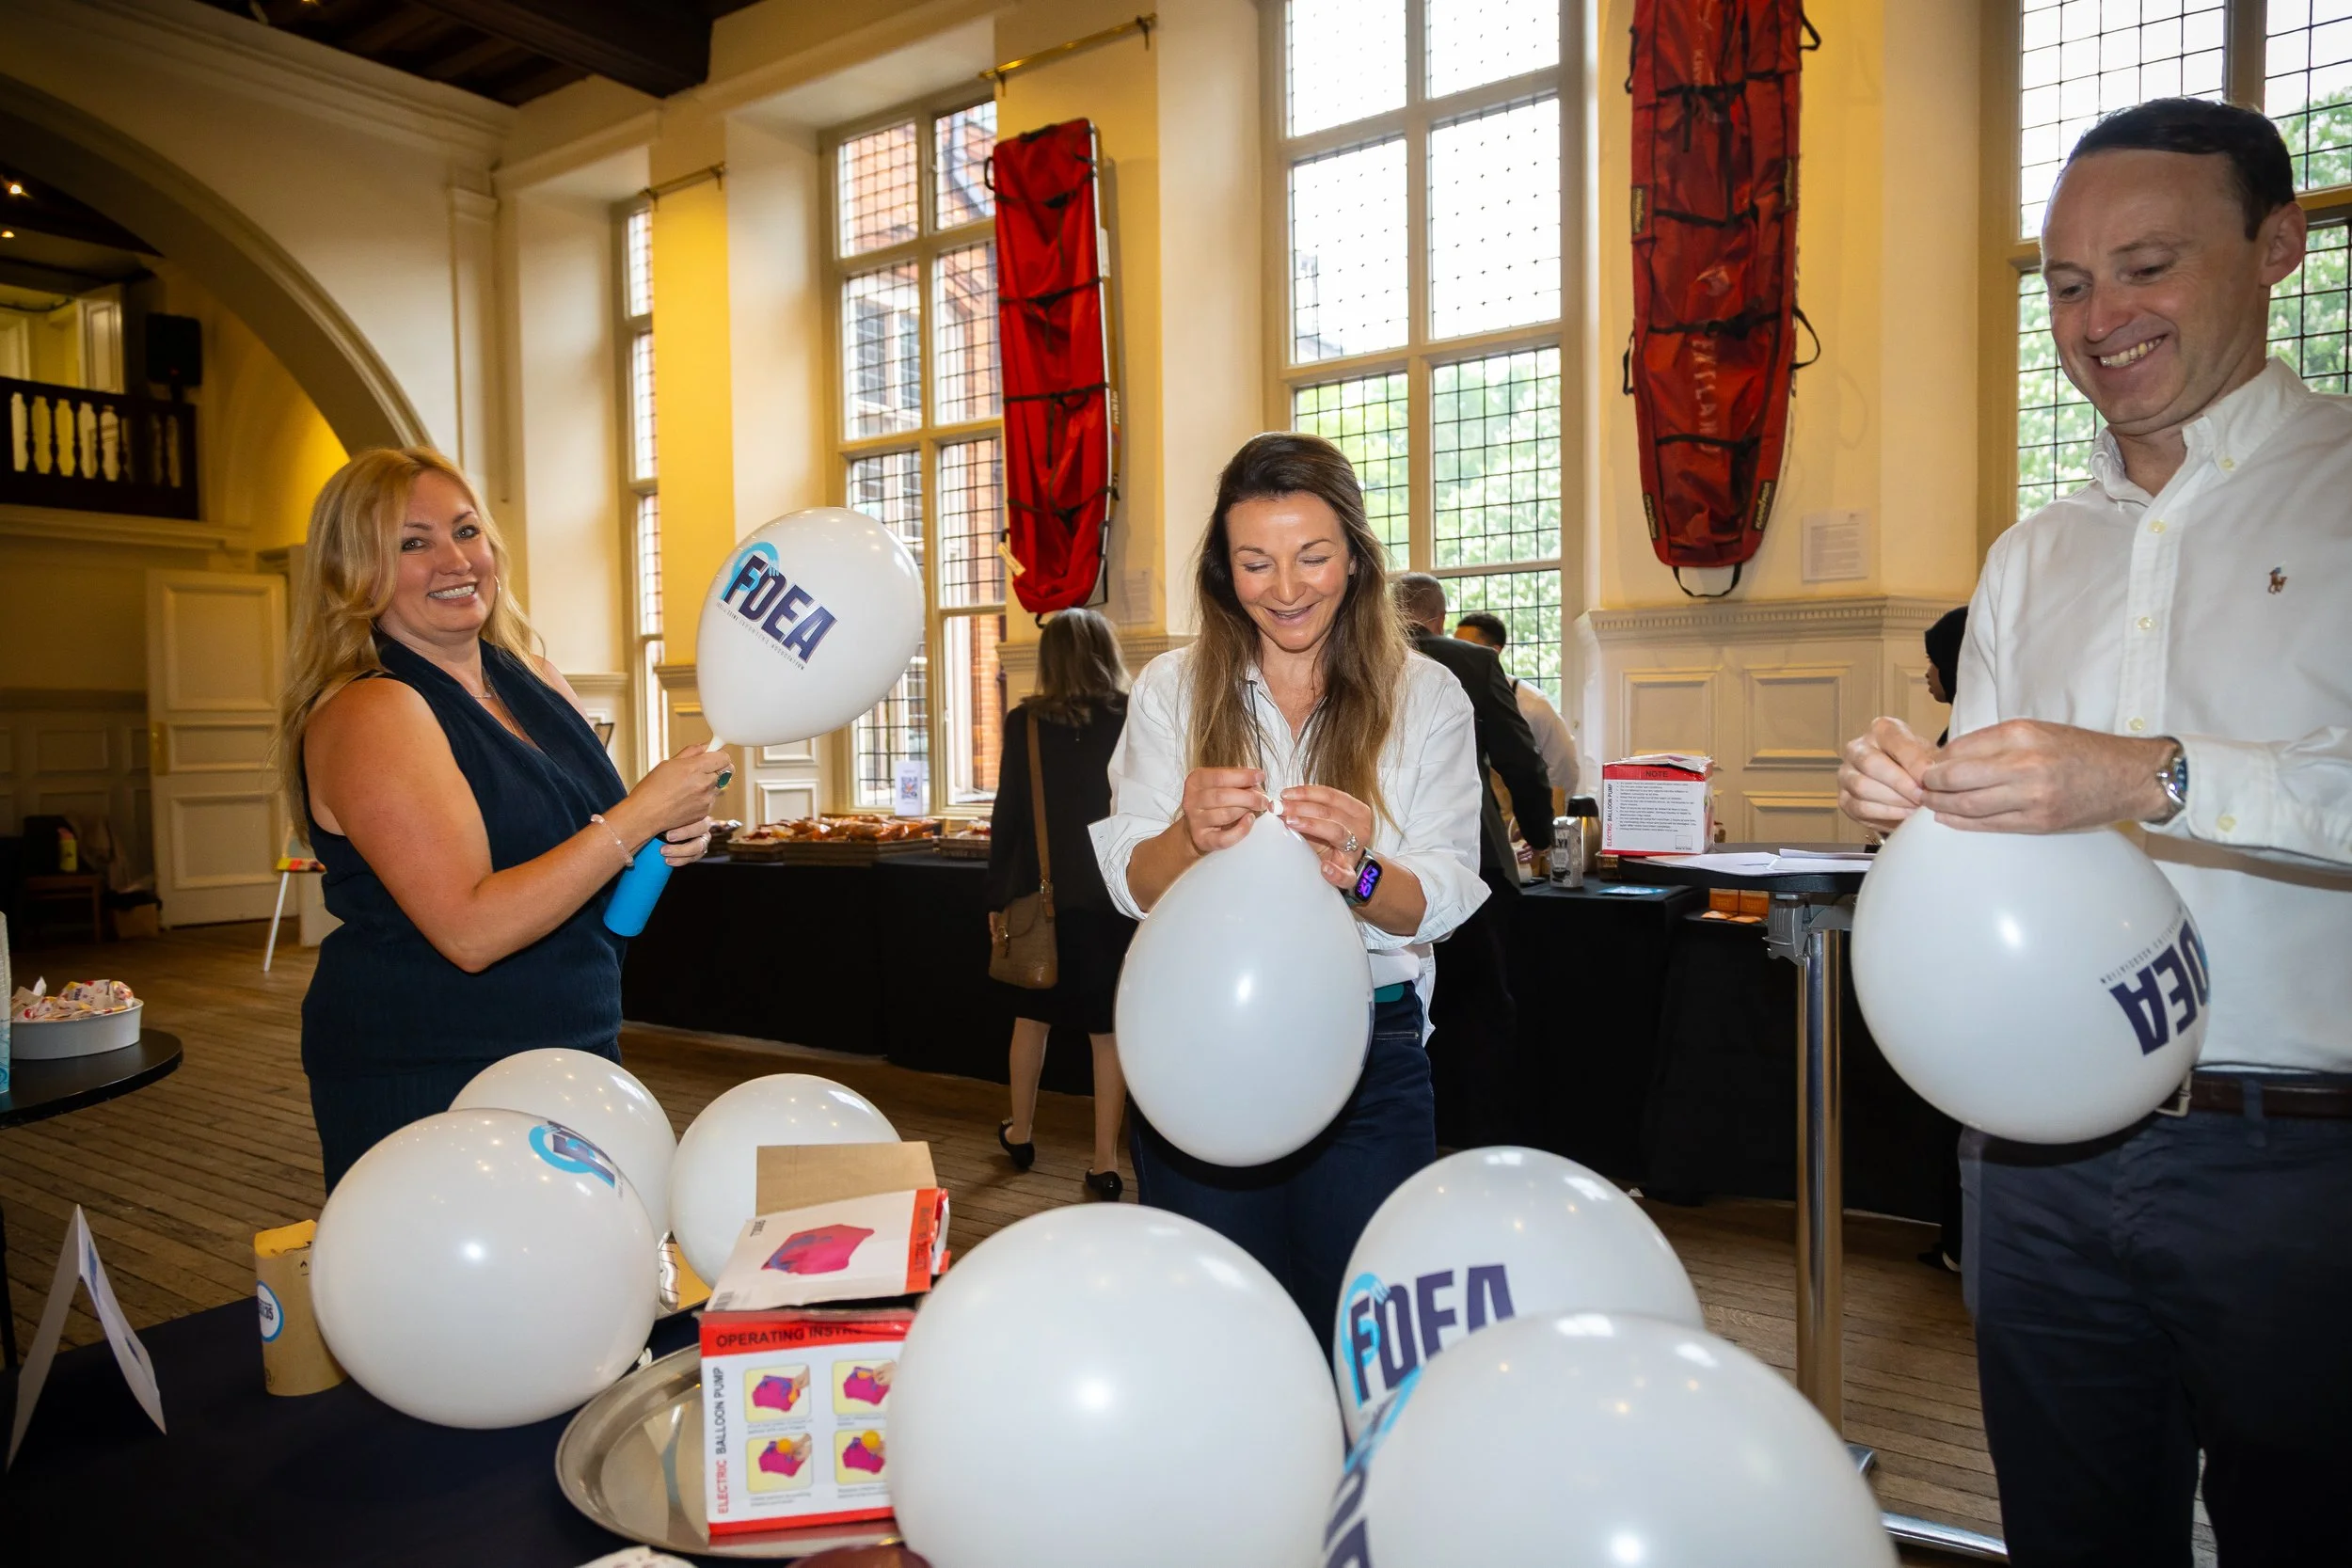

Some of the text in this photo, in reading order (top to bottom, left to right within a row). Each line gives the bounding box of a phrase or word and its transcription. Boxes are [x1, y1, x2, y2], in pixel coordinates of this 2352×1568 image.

[723, 553, 838, 664] FDEA
[2108, 918, 2210, 1056] DEA
[716, 1325, 862, 1348] OPERATING INSTR
[713, 1367, 728, 1513] ELECTRIC BALLOON PUMP
